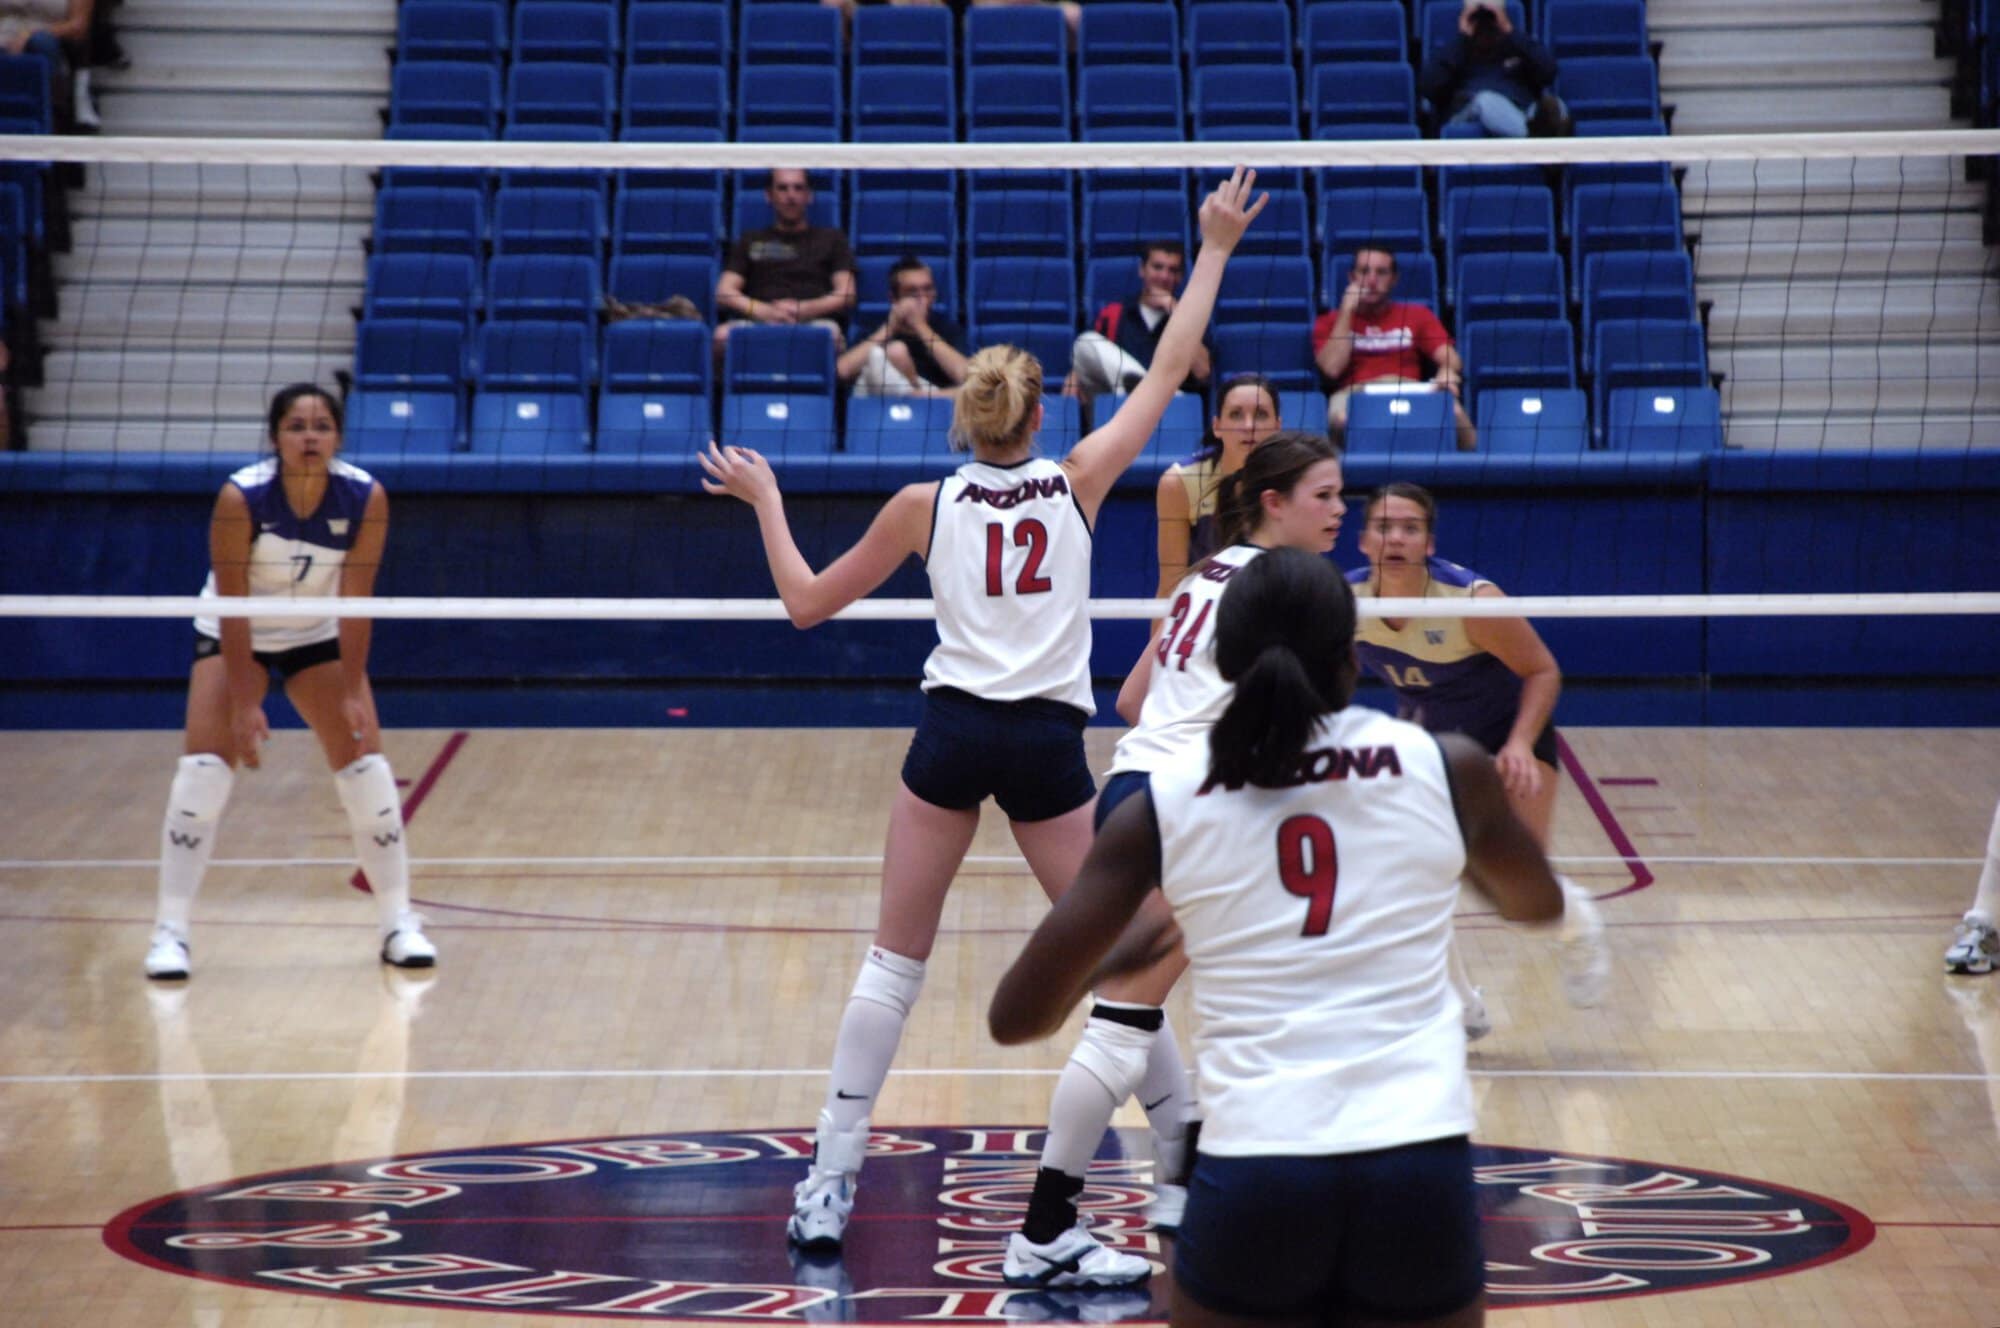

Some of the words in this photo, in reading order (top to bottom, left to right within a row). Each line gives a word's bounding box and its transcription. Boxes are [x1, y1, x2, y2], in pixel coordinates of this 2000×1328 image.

[955, 474, 1068, 509] ARIZONA
[290, 554, 313, 582] 7
[986, 518, 1052, 597] 12
[1158, 592, 1213, 671] 34
[1383, 663, 1432, 687] 14
[1276, 813, 1338, 937] 9
[210, 1129, 1050, 1207] BOBBI
[164, 1210, 402, 1249] &
[255, 1253, 1042, 1320] LUTE
